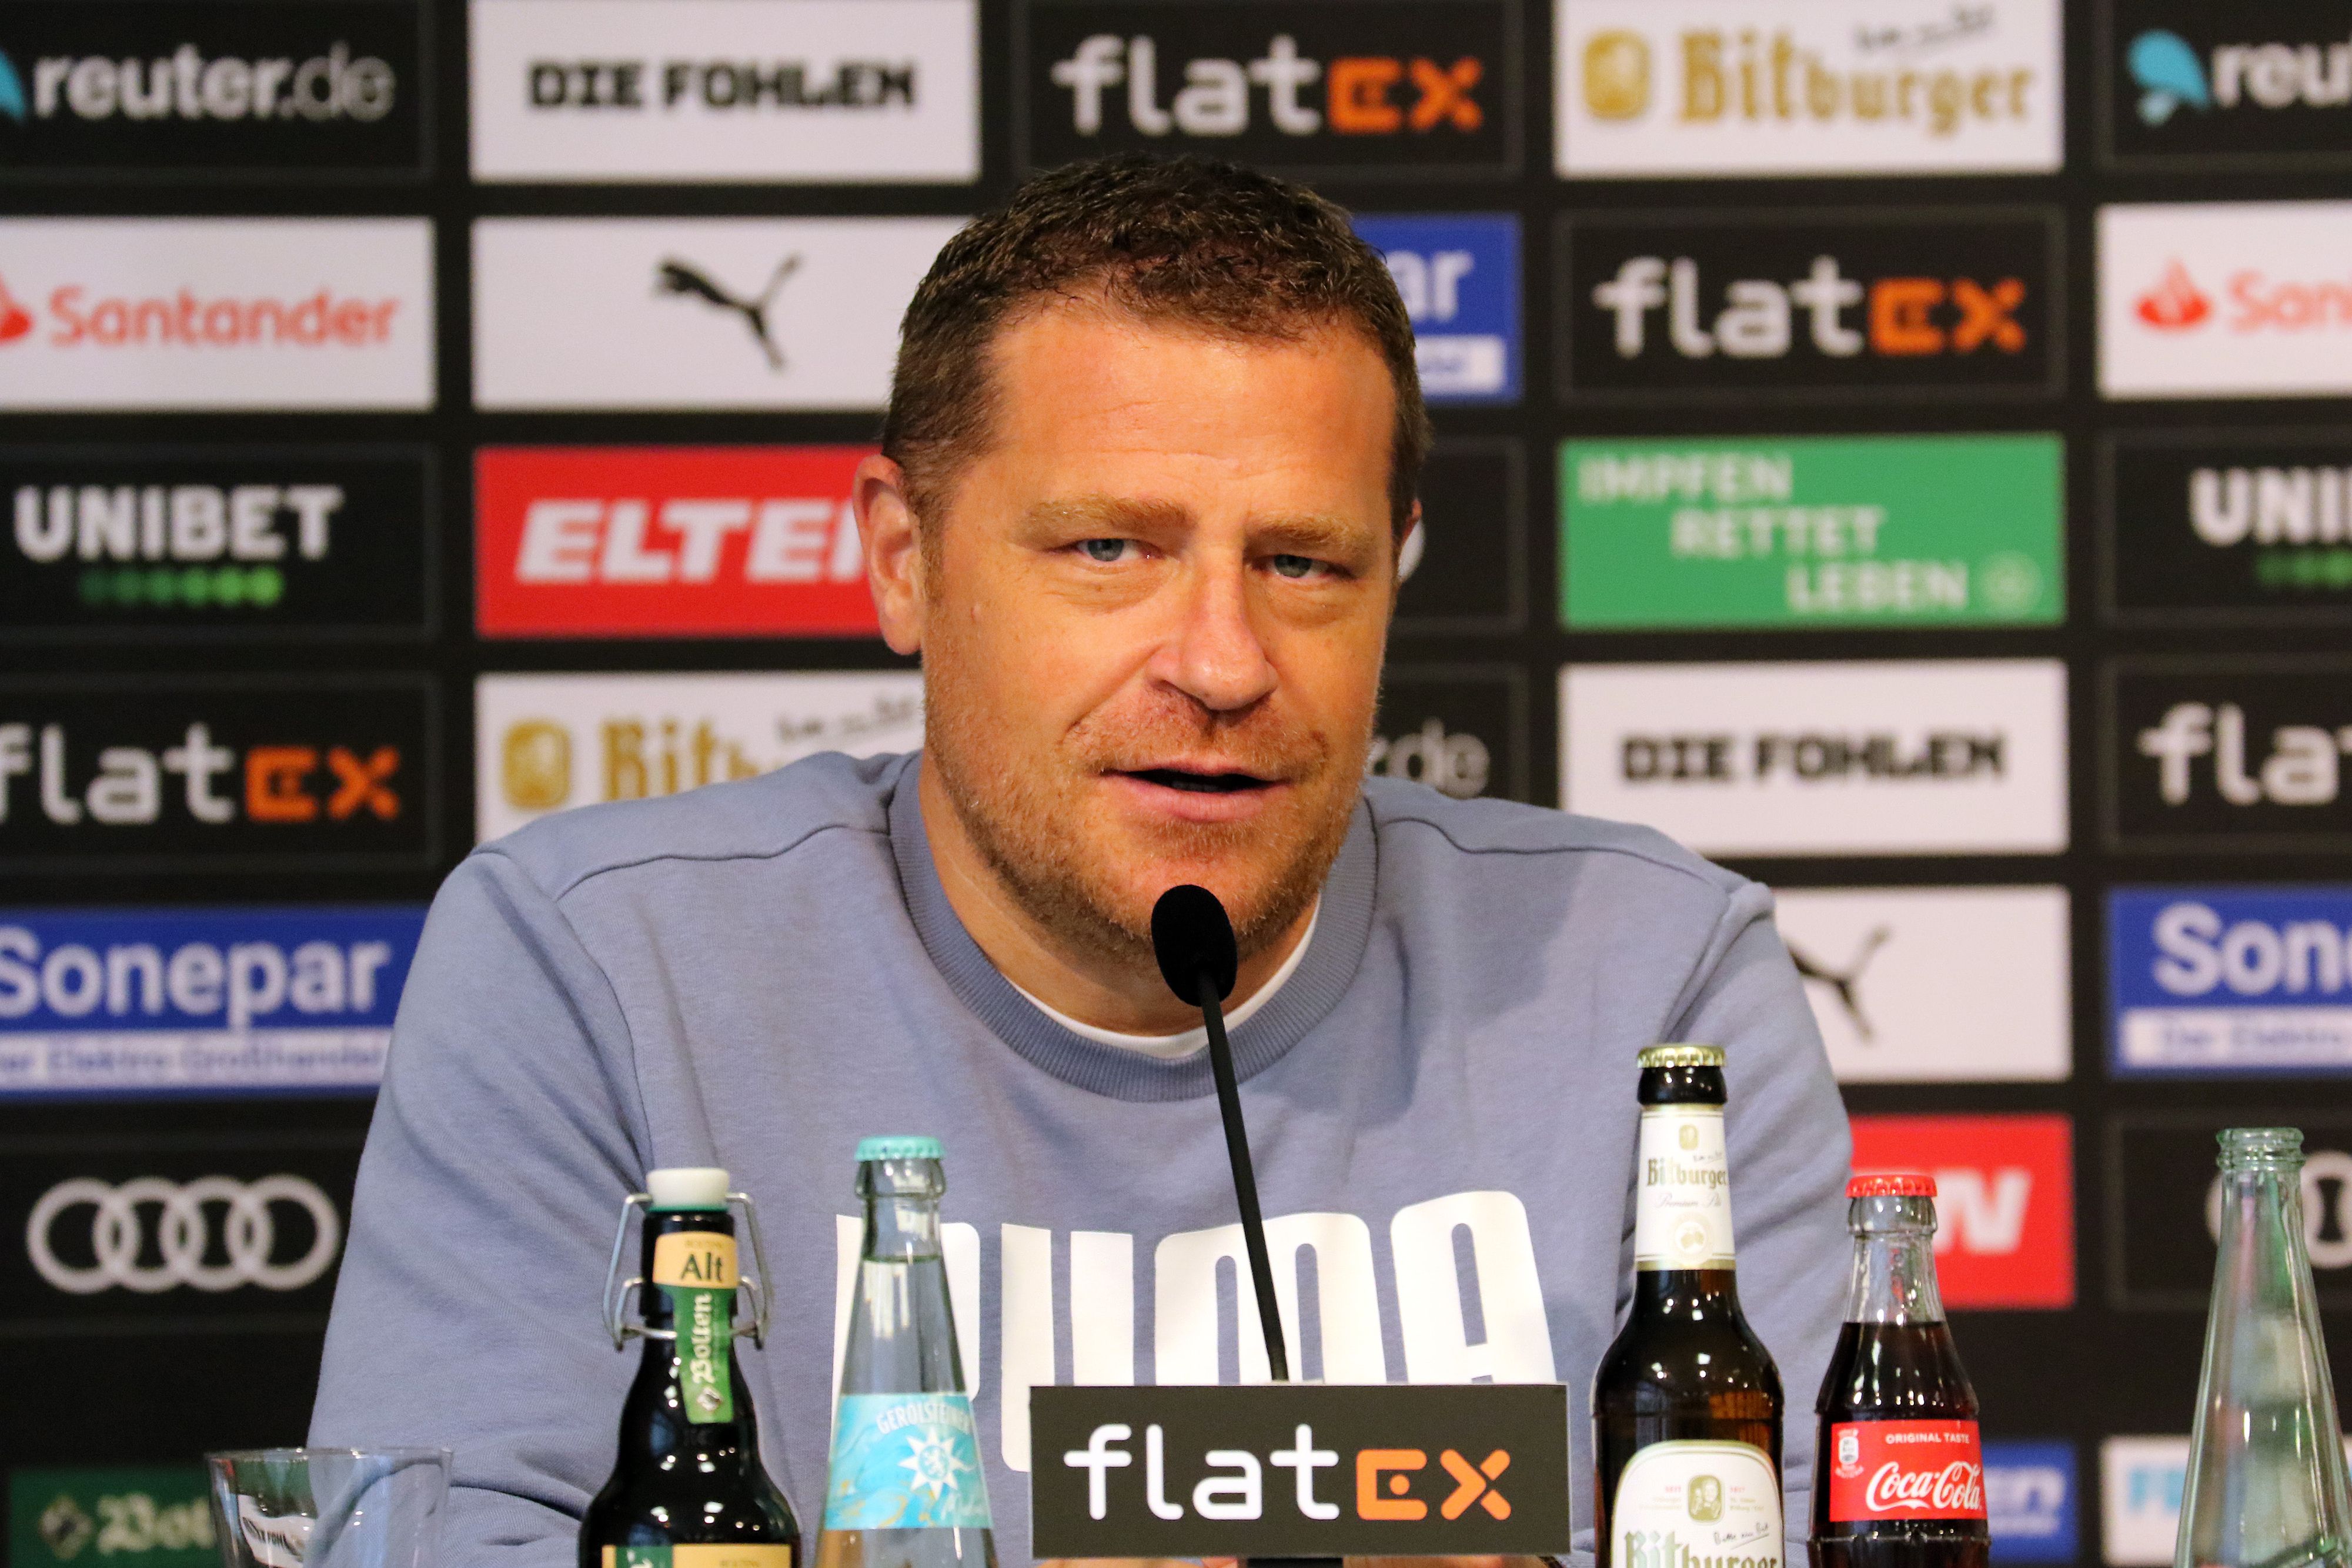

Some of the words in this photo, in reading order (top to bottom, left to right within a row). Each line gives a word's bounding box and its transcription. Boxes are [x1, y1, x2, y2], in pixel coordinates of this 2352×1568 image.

[32, 41, 395, 121] reuter.de
[527, 61, 642, 110] DIE
[664, 60, 916, 110] FOHLEN
[1677, 27, 2034, 142] Bitburger
[49, 285, 400, 346] Santander
[1577, 453, 1793, 504] IMPFEN
[14, 484, 345, 561] UNIBET
[1670, 503, 1886, 559] RETTET
[1786, 559, 1968, 614] LEBEN
[1622, 733, 1733, 783] DIE
[1755, 731, 2005, 783] FOHLEN
[2137, 701, 2352, 807] fla
[2153, 901, 2352, 996] Son
[0, 927, 391, 1034] Sonepar
[1647, 1157, 1728, 1189] Bitburger
[680, 1252, 723, 1282] Alt
[1886, 1433, 1942, 1445] ORIGINAL
[1944, 1432, 1970, 1444] TASTE
[1866, 1461, 1981, 1512] Coca-Cola
